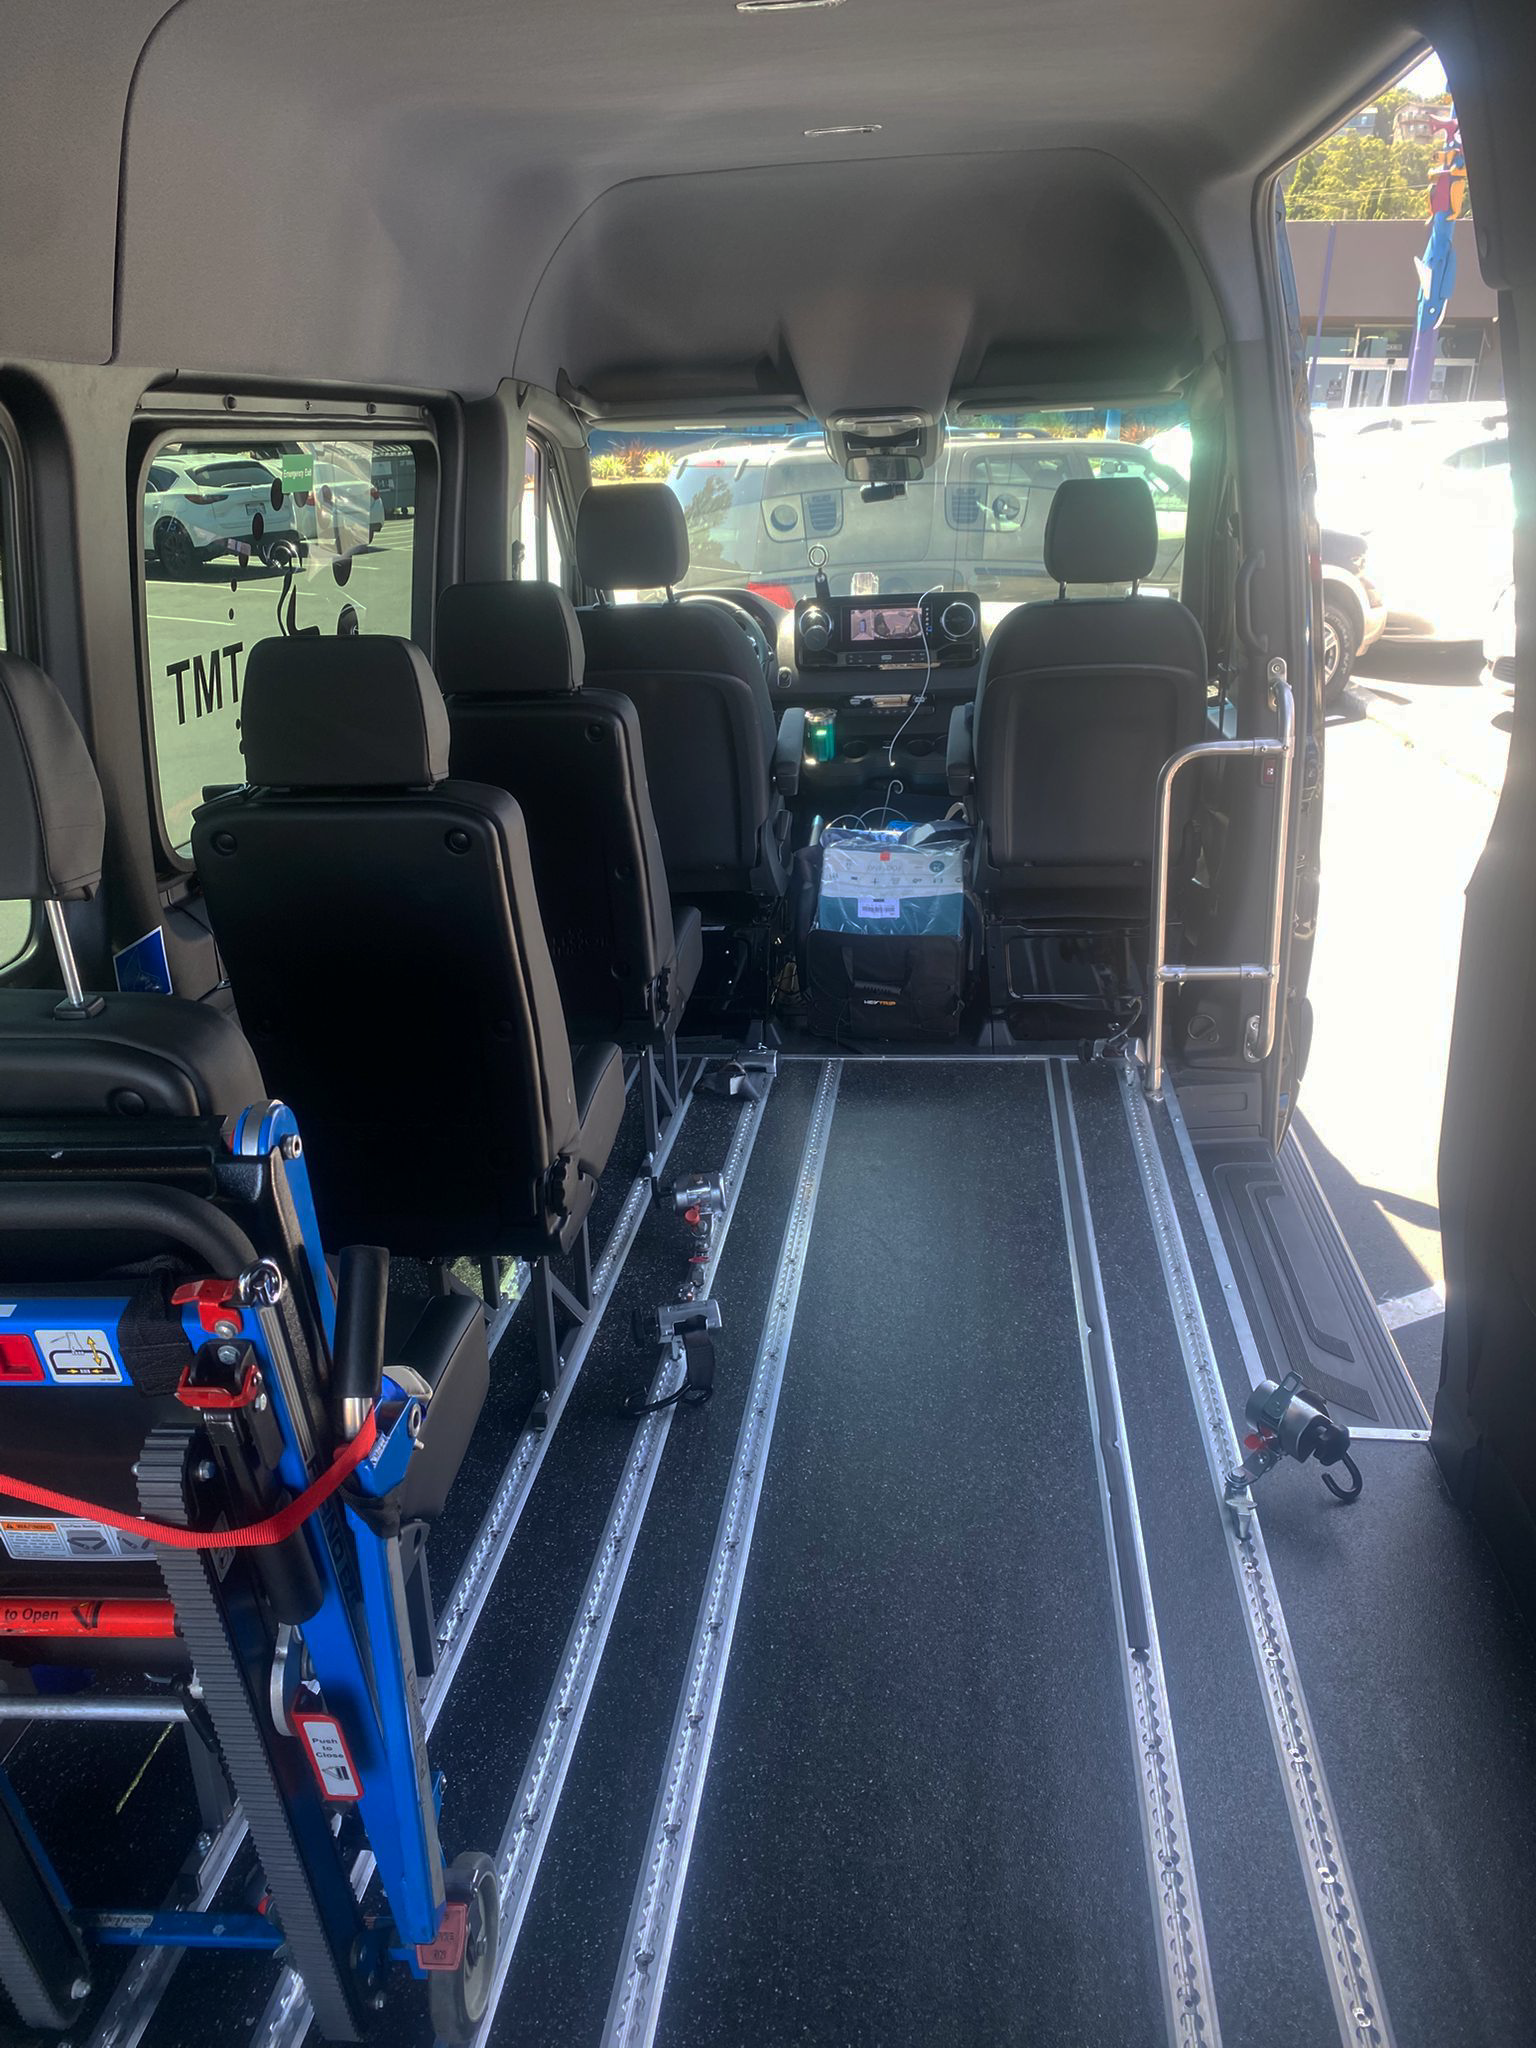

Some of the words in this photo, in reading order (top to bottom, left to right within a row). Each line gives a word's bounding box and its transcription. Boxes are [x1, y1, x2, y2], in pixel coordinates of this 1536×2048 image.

[283, 469, 304, 479] Emergency
[166, 641, 243, 725] TMT
[4, 1608, 18, 1621] to
[22, 1607, 59, 1623] Open
[315, 1751, 344, 1759] Close
